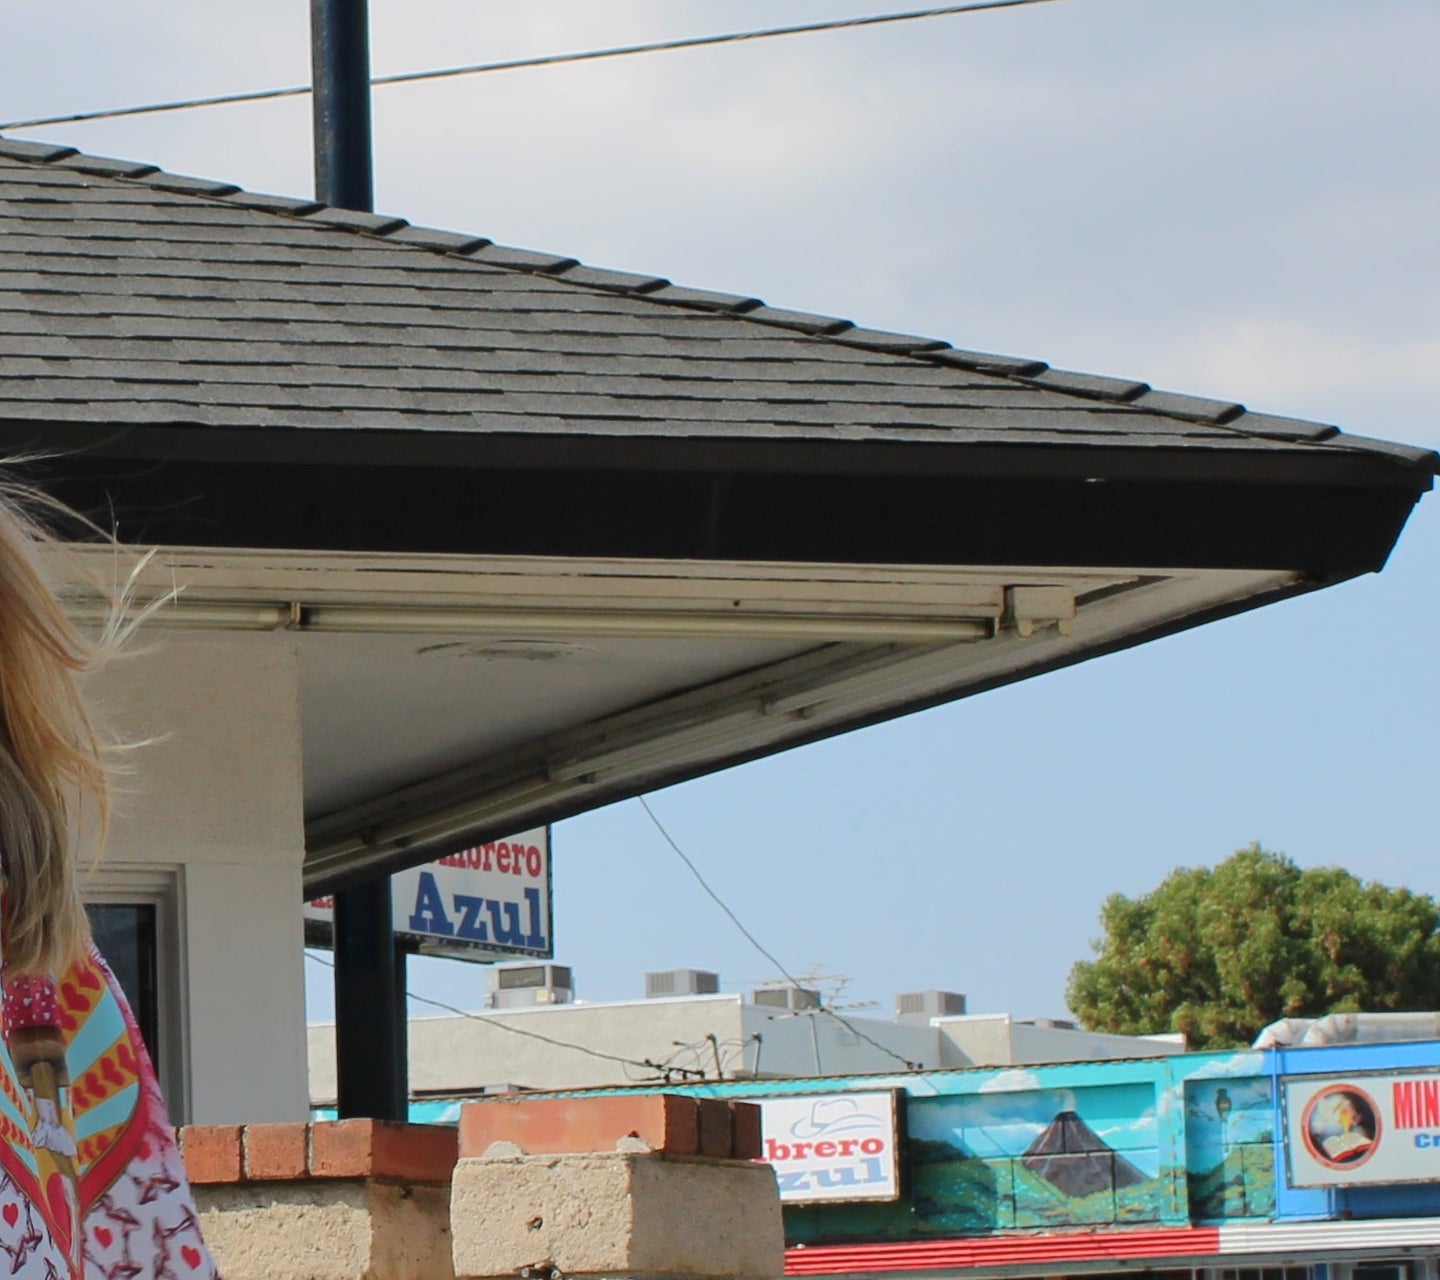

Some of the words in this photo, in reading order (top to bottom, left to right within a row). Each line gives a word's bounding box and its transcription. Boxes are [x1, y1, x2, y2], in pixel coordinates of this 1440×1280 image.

[430, 842, 542, 878] brero
[409, 872, 545, 949] Azul
[751, 1138, 884, 1164] brero
[777, 1157, 888, 1191] zul
